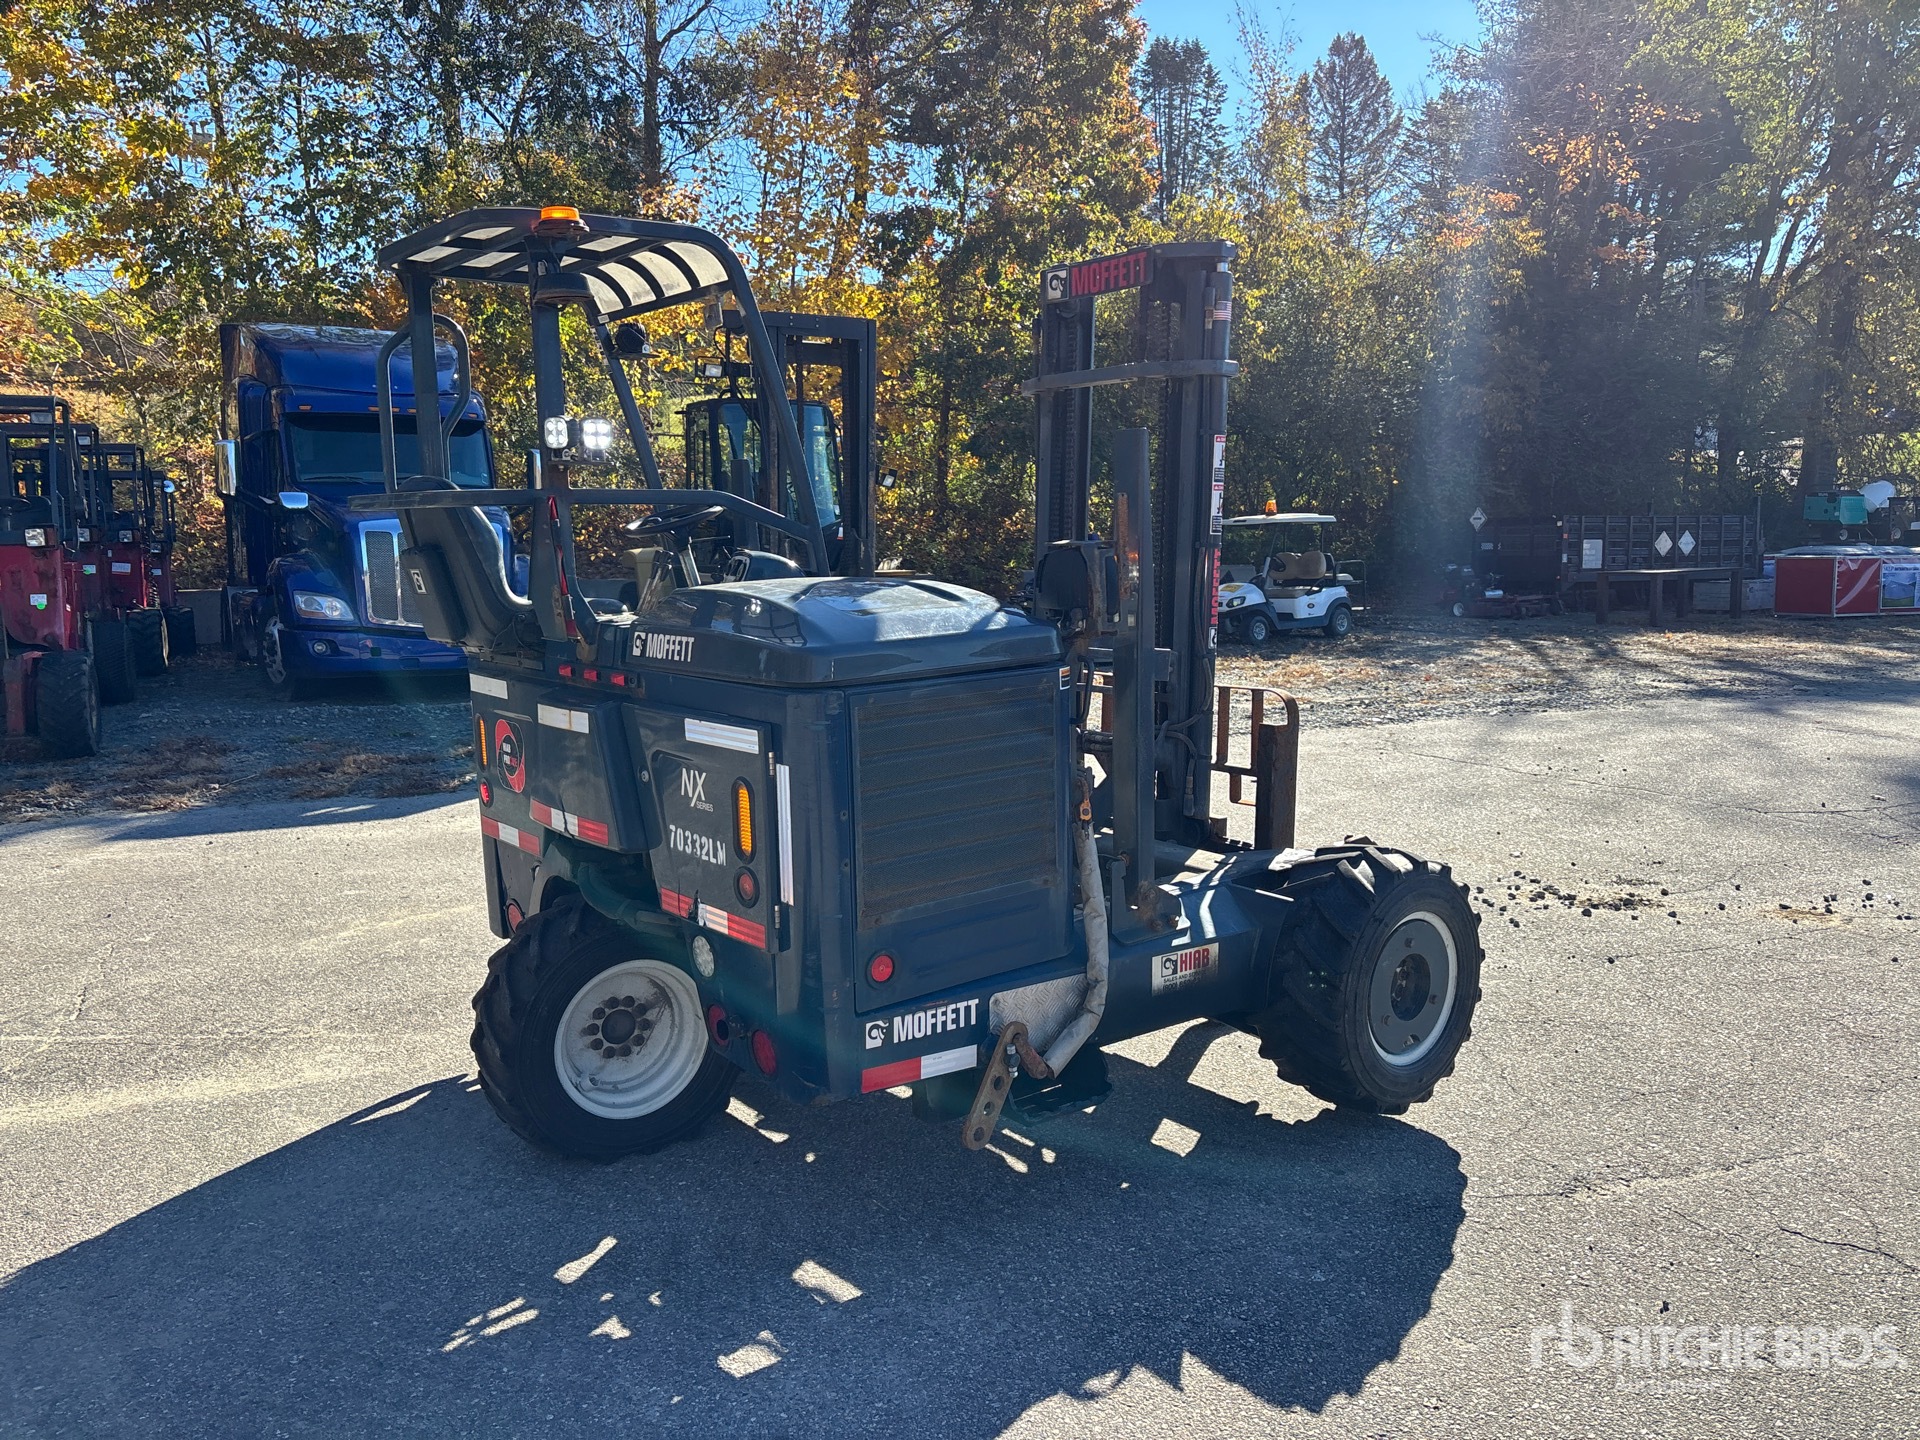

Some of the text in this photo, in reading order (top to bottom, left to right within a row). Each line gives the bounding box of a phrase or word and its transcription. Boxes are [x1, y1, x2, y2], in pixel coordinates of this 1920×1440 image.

[1071, 251, 1147, 297] MOFFETT
[645, 632, 695, 663] MOFFETT
[681, 767, 707, 807] NX
[696, 800, 714, 812] SERIES
[1180, 947, 1210, 973] HIAB
[893, 998, 979, 1044] MOFFETT
